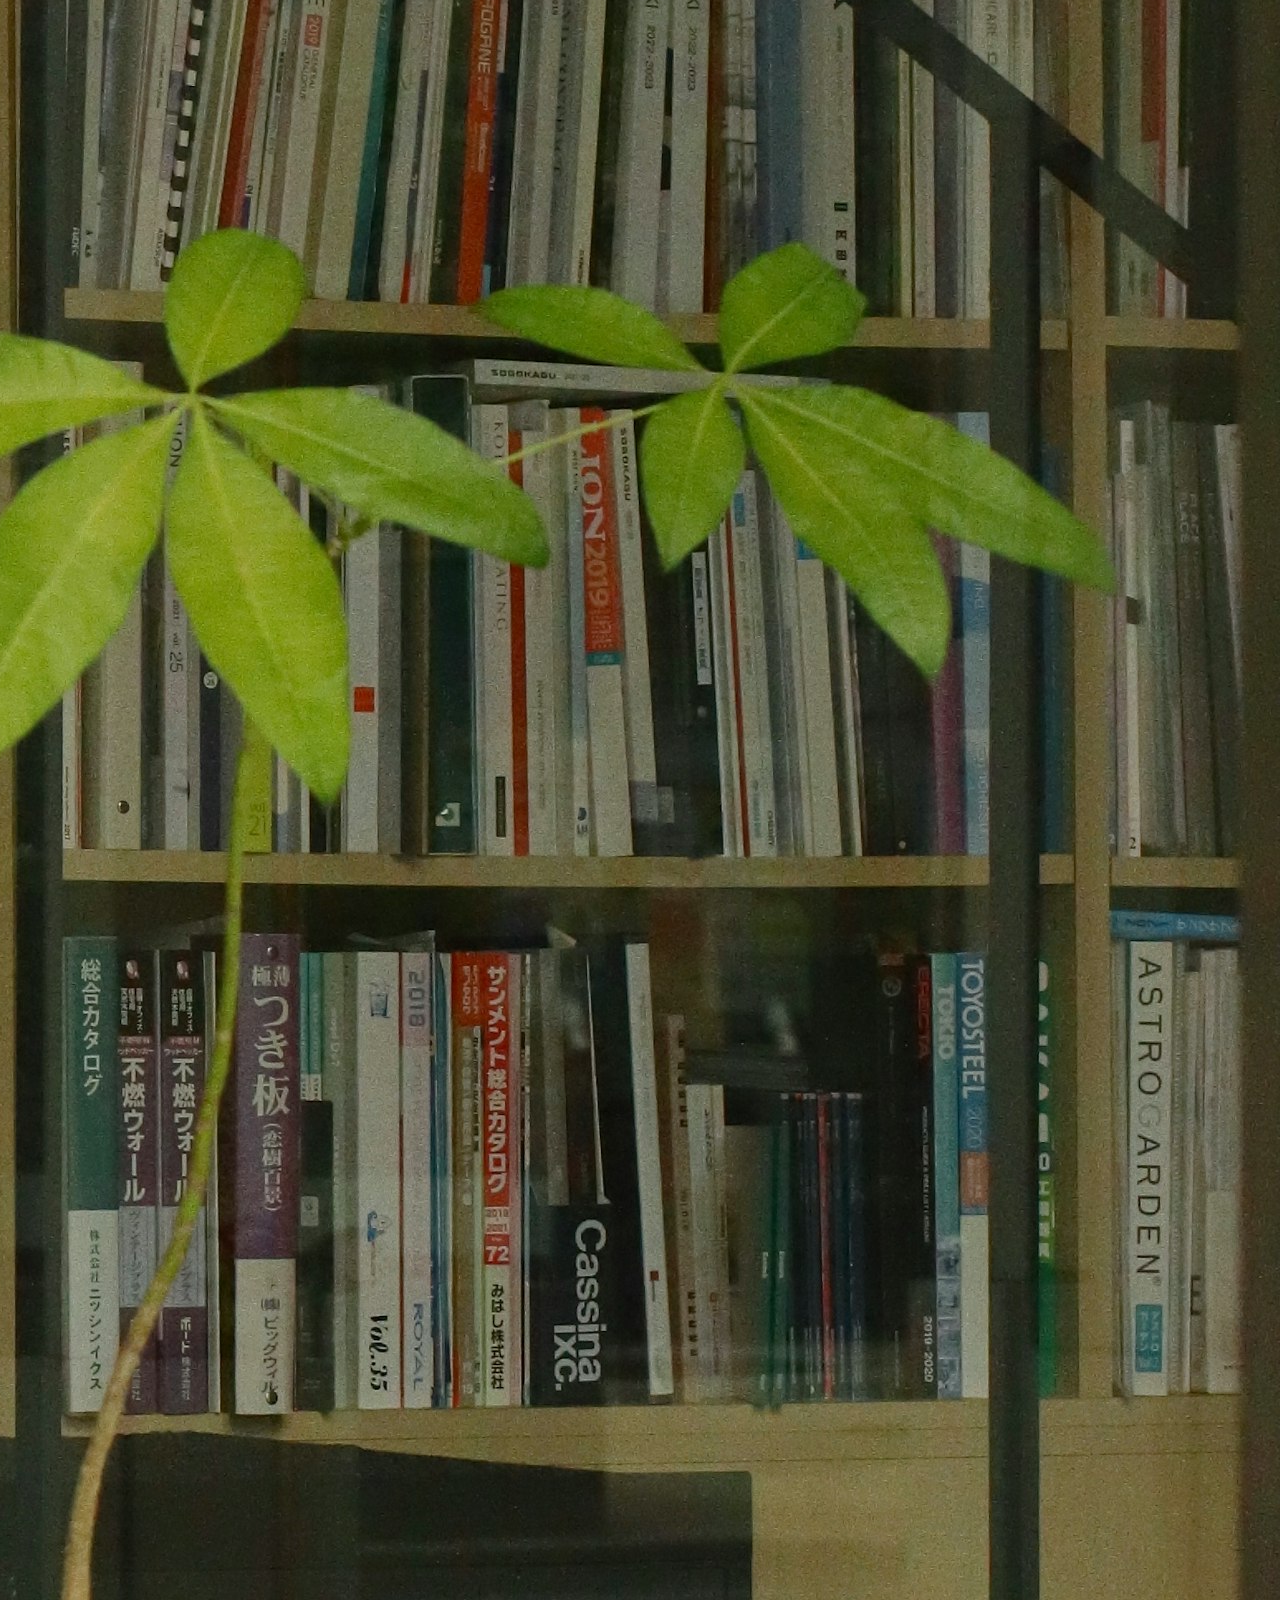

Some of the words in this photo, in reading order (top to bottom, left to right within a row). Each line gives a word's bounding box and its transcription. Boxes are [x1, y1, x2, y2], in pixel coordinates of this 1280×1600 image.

[590, 542, 610, 607] 2019
[80, 958, 102, 1097] 総合カタログ
[251, 993, 290, 1117] つき板
[487, 965, 508, 1194] サンメント総合カタログ
[961, 960, 984, 1101] TOYOSTEEL
[121, 1060, 147, 1203] 不燃ウォール
[485, 1245, 510, 1262] 72
[574, 1220, 609, 1384] Cassina
[88, 1287, 102, 1391] ニッシンイクス
[366, 1314, 388, 1392] Vol.35
[411, 1303, 425, 1391] ROYAL
